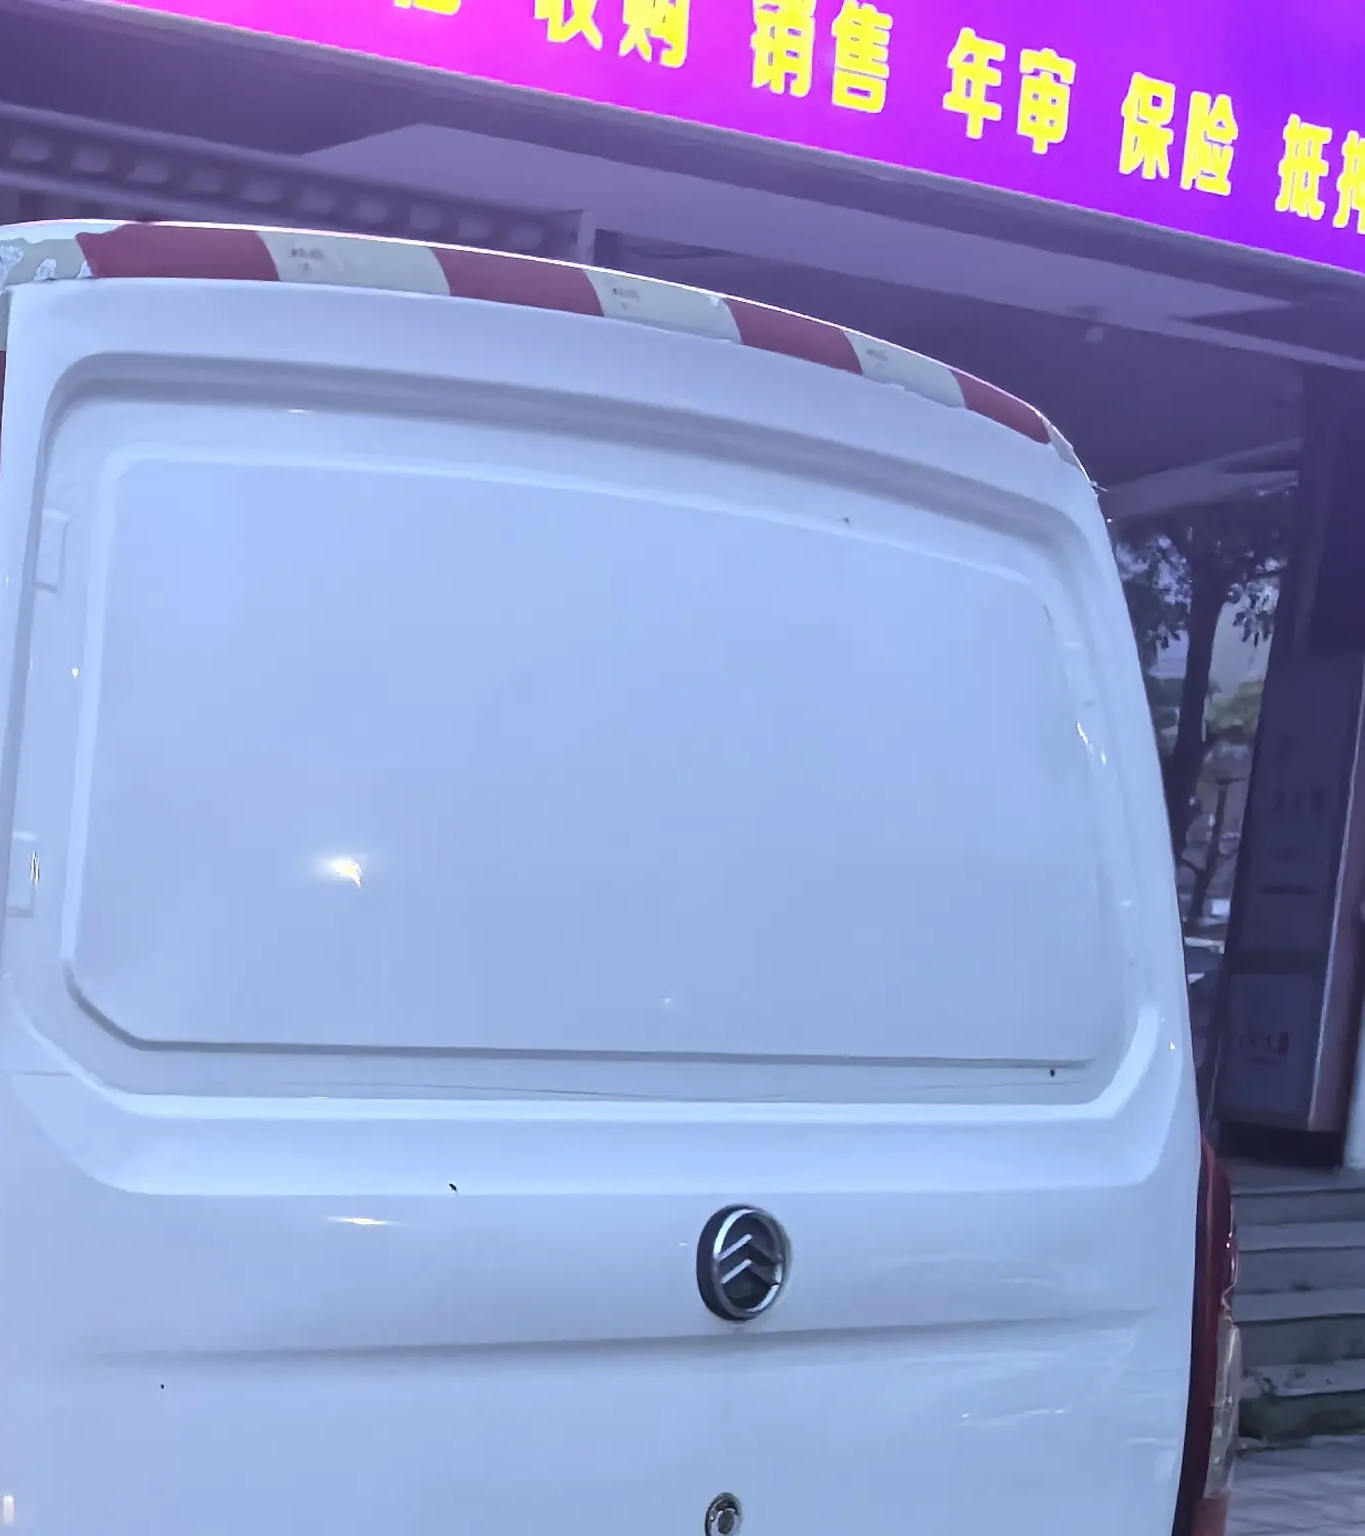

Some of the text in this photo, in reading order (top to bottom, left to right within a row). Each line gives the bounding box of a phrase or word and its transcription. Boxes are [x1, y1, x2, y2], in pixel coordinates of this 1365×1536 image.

[751, 0, 893, 113] 销售
[942, 26, 1076, 155] 年审
[1119, 71, 1239, 196] 保险
